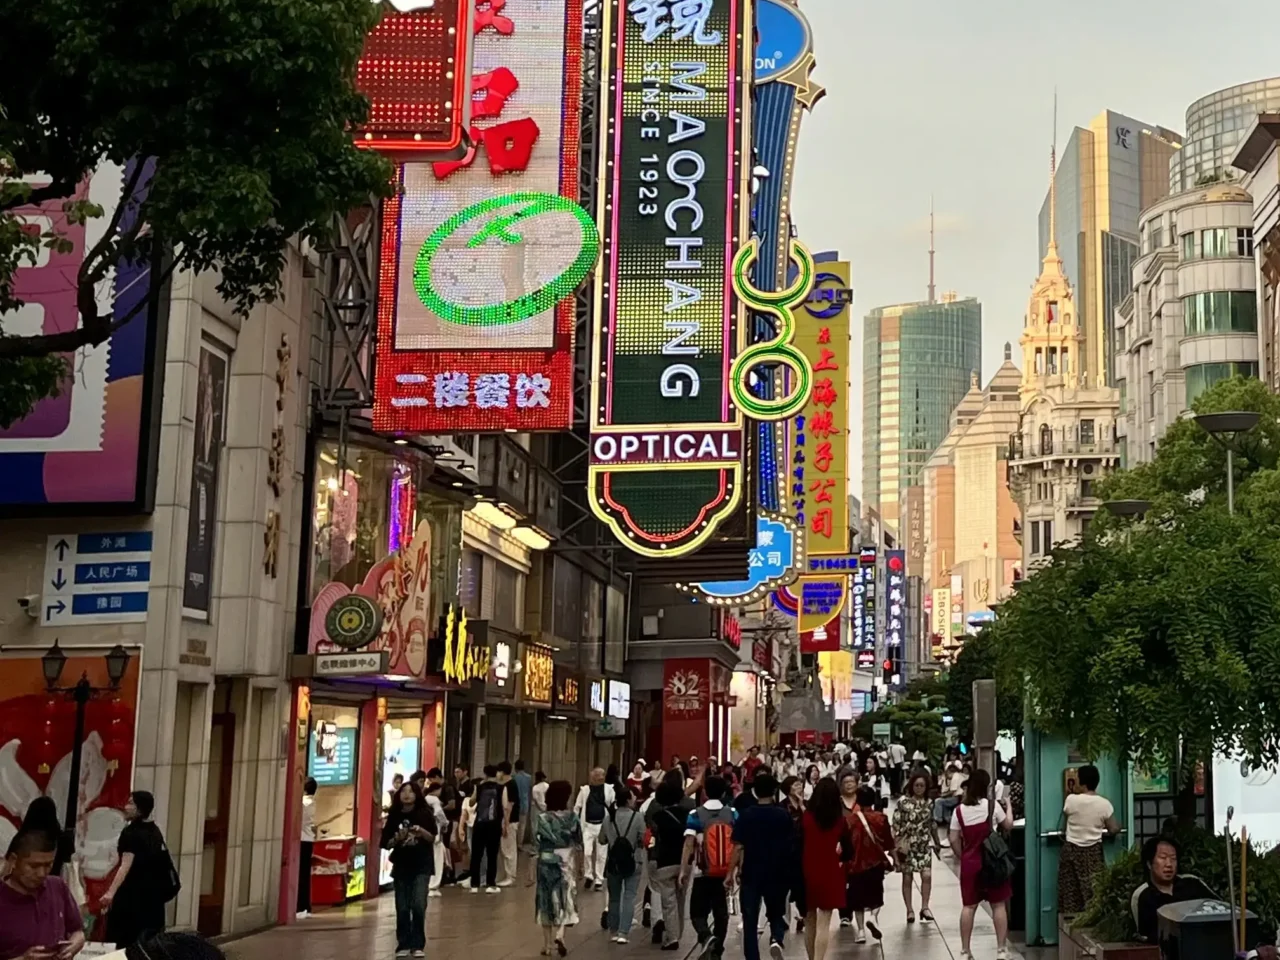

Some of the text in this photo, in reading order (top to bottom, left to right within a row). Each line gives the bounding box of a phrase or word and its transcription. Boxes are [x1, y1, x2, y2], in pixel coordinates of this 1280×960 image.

[638, 60, 662, 216] SINCE 1923
[661, 60, 707, 399] MAOCHANG
[392, 371, 552, 409] 二楼餐饮
[593, 433, 738, 461] OPTICAL
[85, 565, 139, 579] 人民广场
[672, 673, 700, 696] 82
